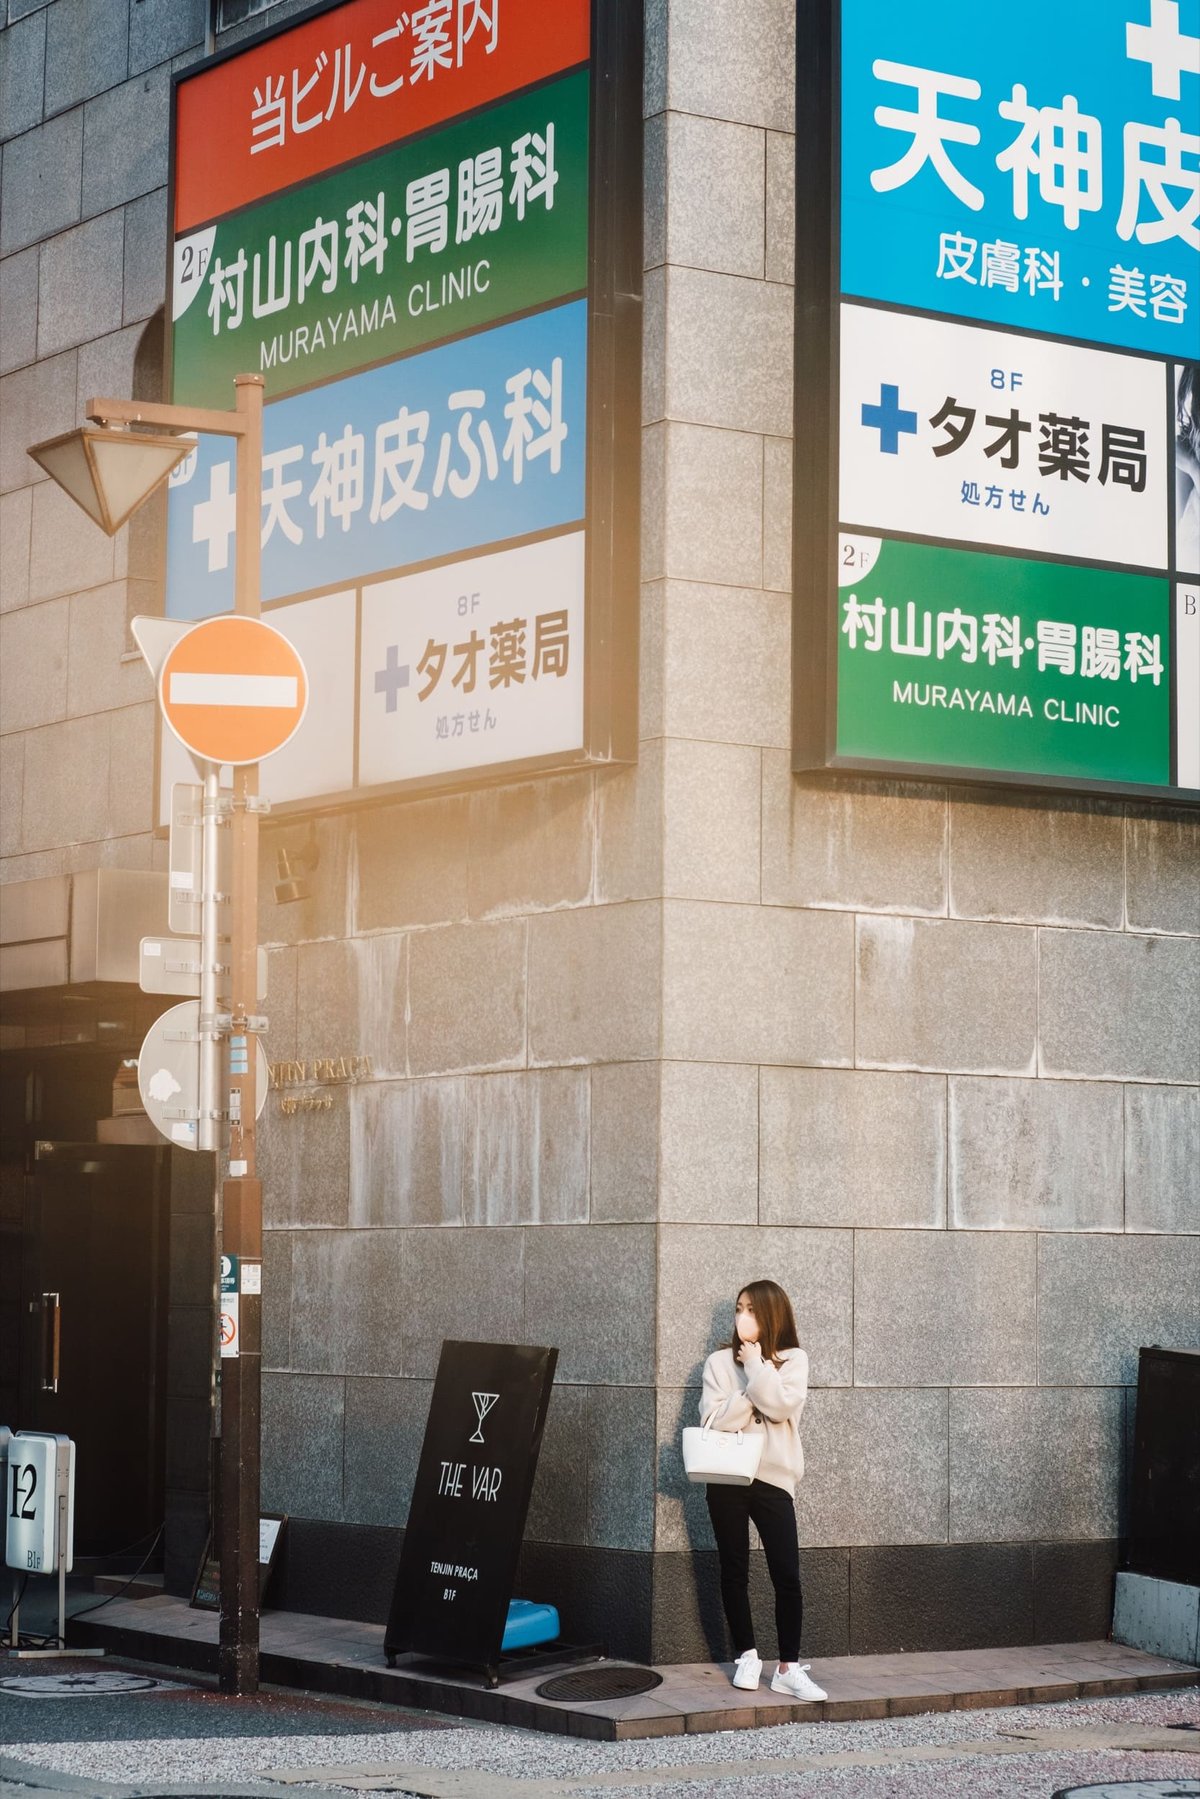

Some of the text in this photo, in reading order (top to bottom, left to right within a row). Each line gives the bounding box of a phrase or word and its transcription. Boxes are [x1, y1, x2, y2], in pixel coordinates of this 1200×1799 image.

[250, 0, 498, 155] 当ビルご案内
[180, 245, 208, 284] 2F
[260, 260, 490, 370] MURAYAMA CLINIC
[990, 368, 1023, 392] 8F
[261, 357, 568, 550] 天神皮ふ科
[928, 395, 1147, 493] タオ薬局
[960, 480, 1050, 516] 処方せん
[843, 544, 869, 569] 2F
[457, 593, 481, 617] 8F
[416, 609, 569, 702] タオ薬局
[892, 681, 1120, 727] MURAYAMA CLINIC
[435, 708, 497, 740] 処方せん
[267, 1060, 306, 1088] NJIN
[438, 1461, 503, 1502] THE VAR
[430, 1561, 478, 1582] TENJIN PRAÇA
[443, 1588, 457, 1601] B1F
